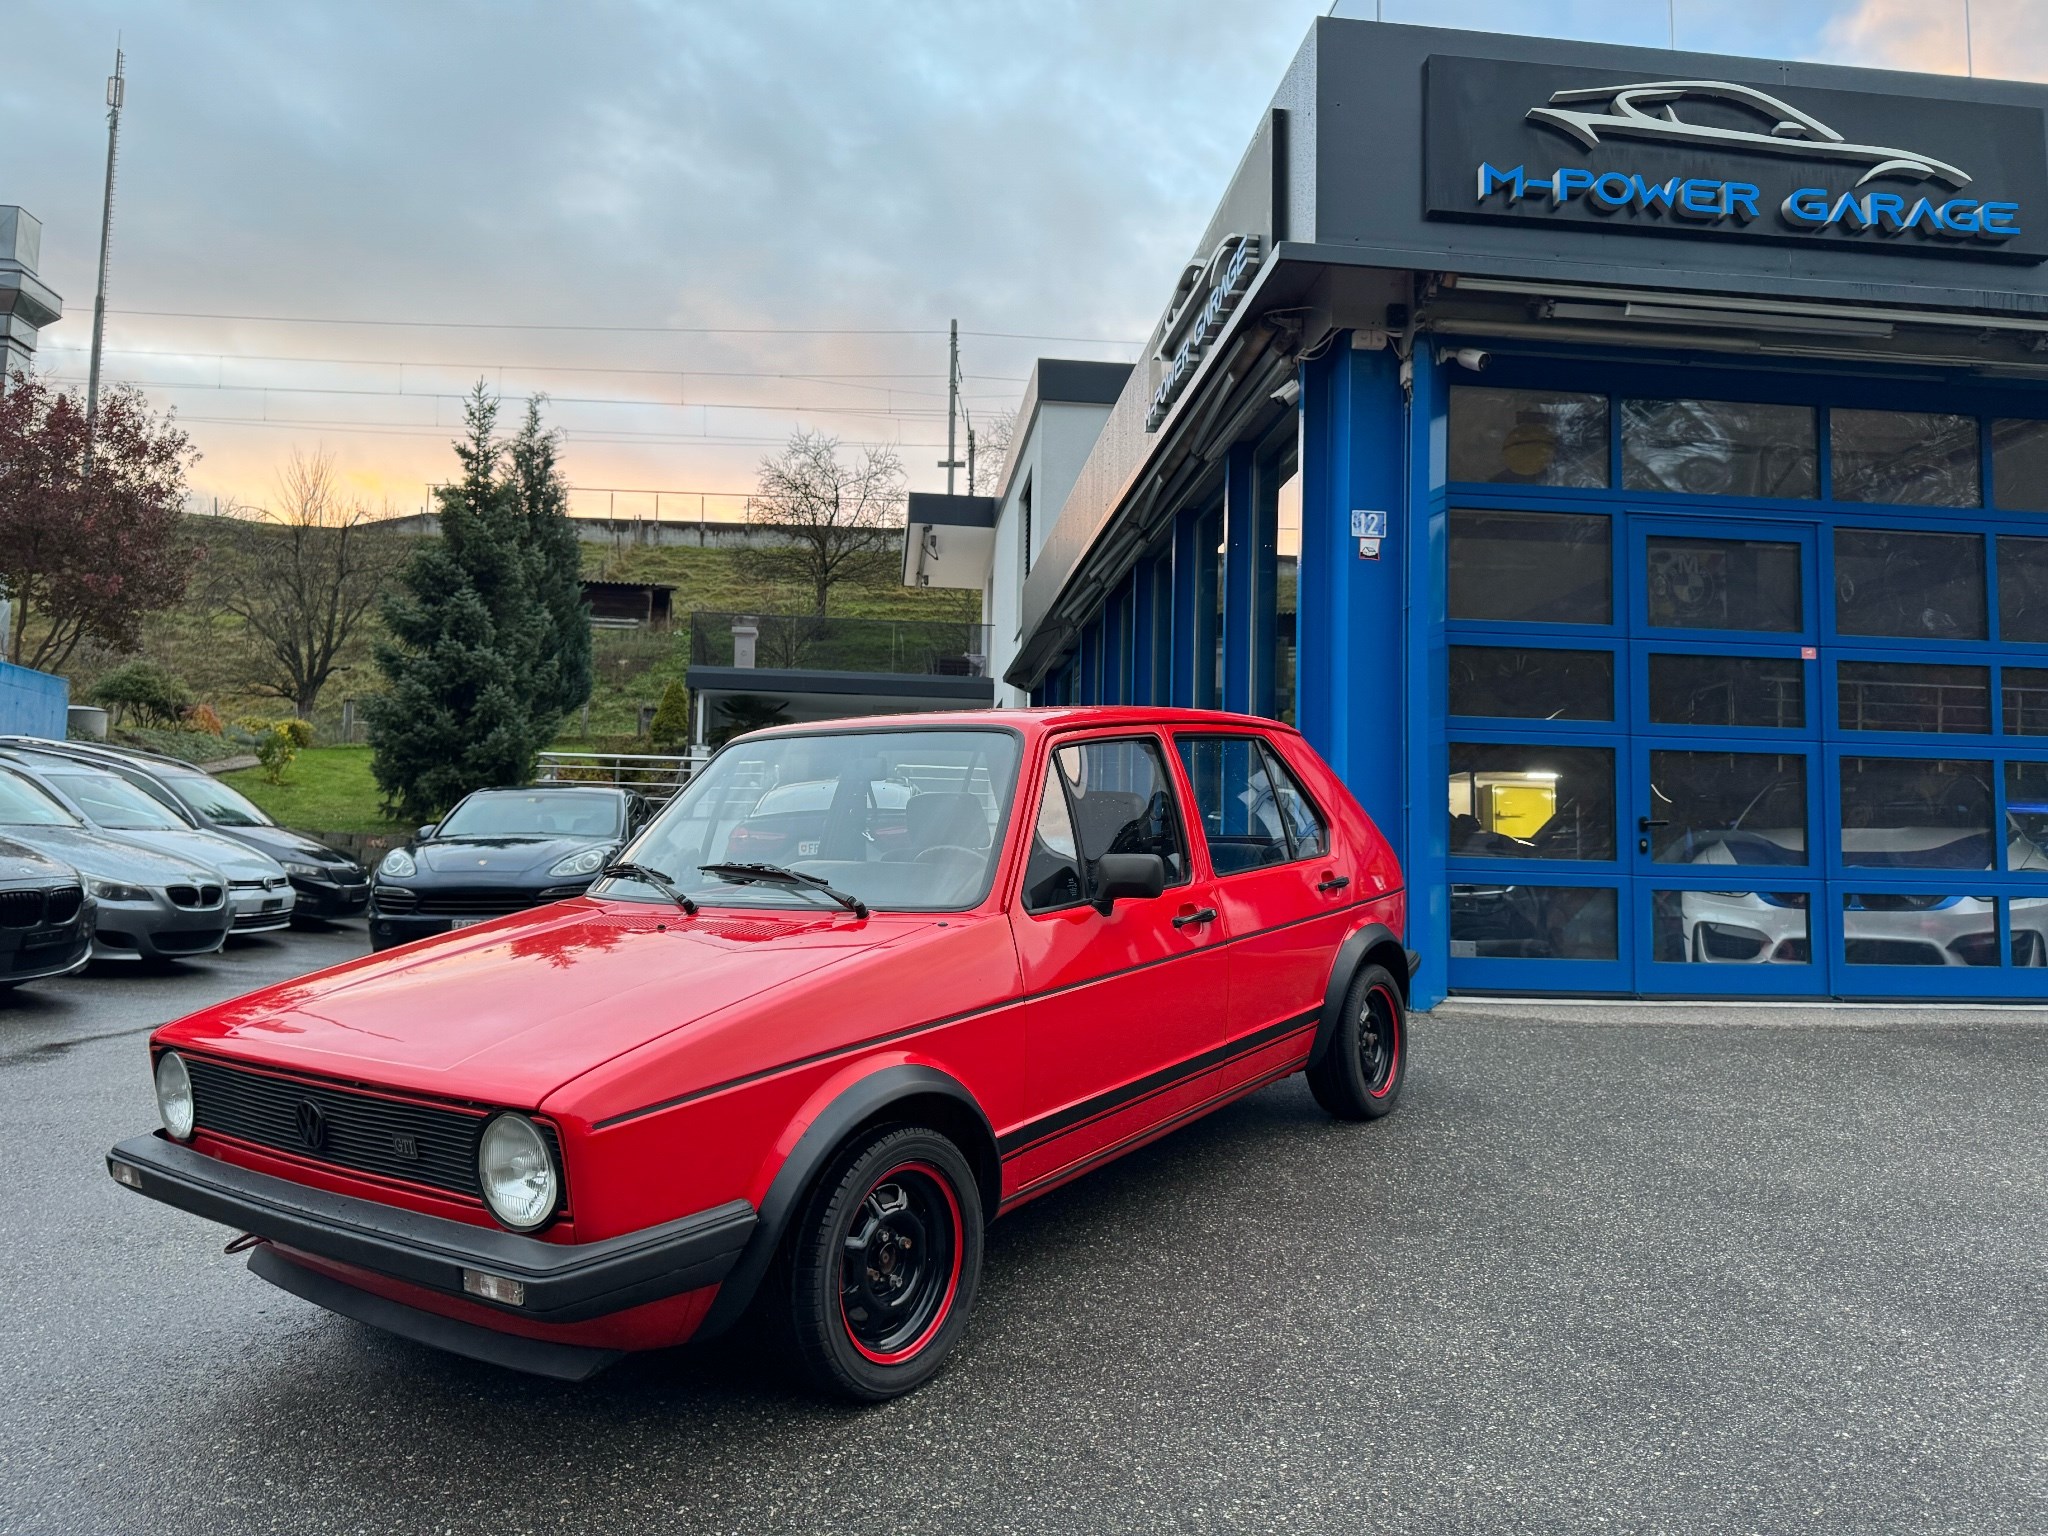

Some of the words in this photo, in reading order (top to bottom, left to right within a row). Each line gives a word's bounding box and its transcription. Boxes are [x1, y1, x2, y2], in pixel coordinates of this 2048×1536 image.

[1478, 161, 1760, 222] M-POWER
[1786, 187, 2022, 238] GARAGE
[1194, 234, 1248, 346] GARAGE
[1360, 512, 1379, 535] 12
[394, 1137, 415, 1155] GTI
